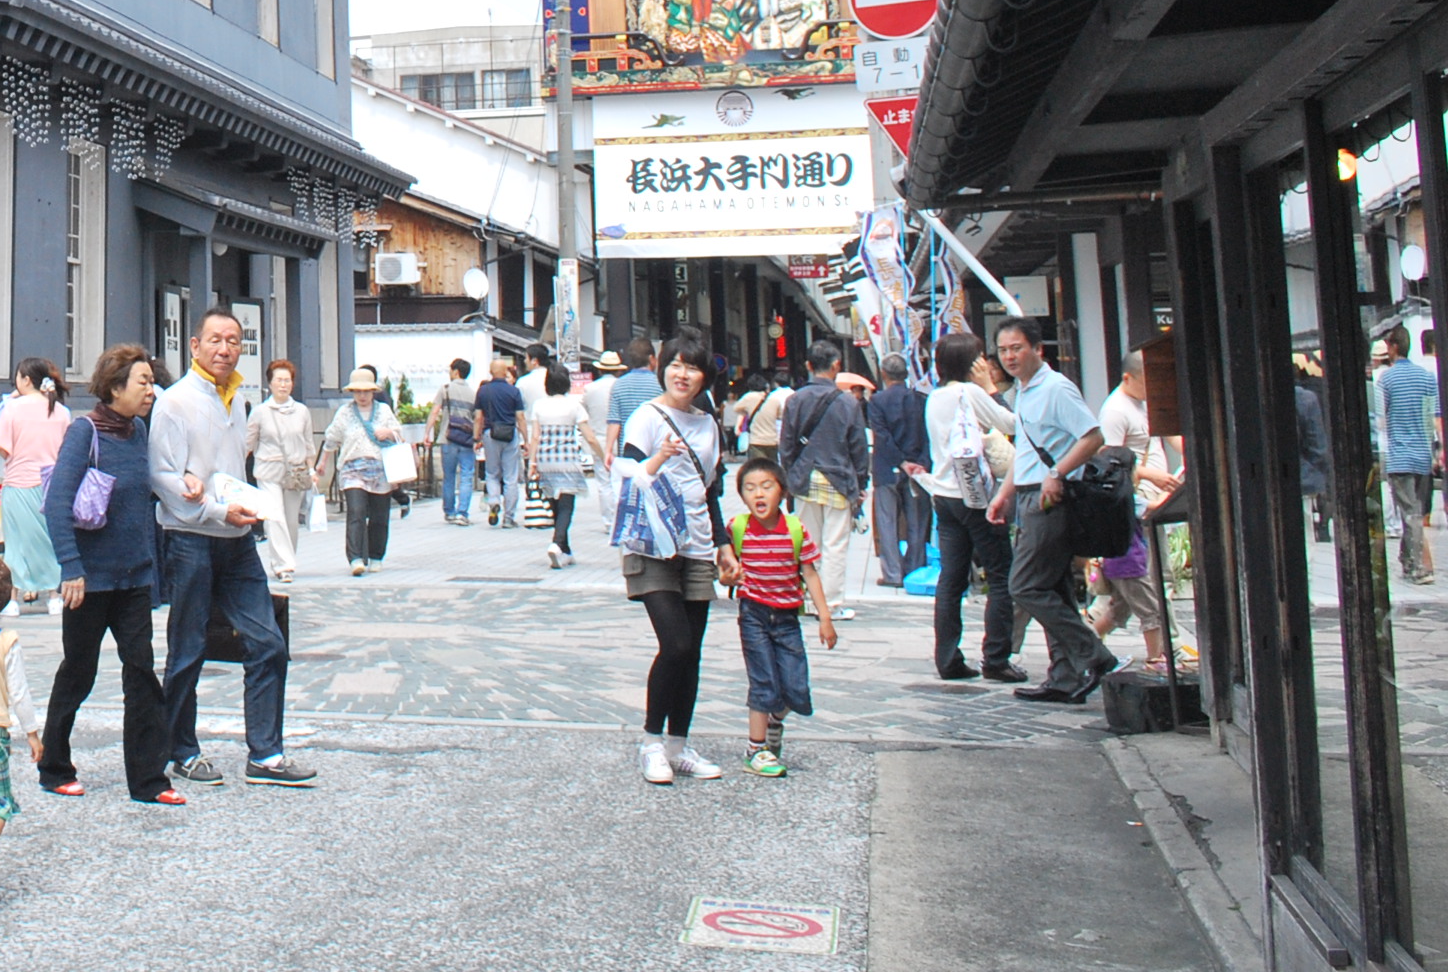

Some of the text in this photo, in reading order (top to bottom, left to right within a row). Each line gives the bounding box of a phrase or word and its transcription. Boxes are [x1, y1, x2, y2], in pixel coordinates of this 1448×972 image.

[862, 45, 929, 66] 自動
[882, 108, 915, 125] 止ま
[626, 151, 852, 194] 長浜大手門通り
[628, 197, 736, 213] NAGAHAMA
[746, 194, 825, 211] OTEMON
